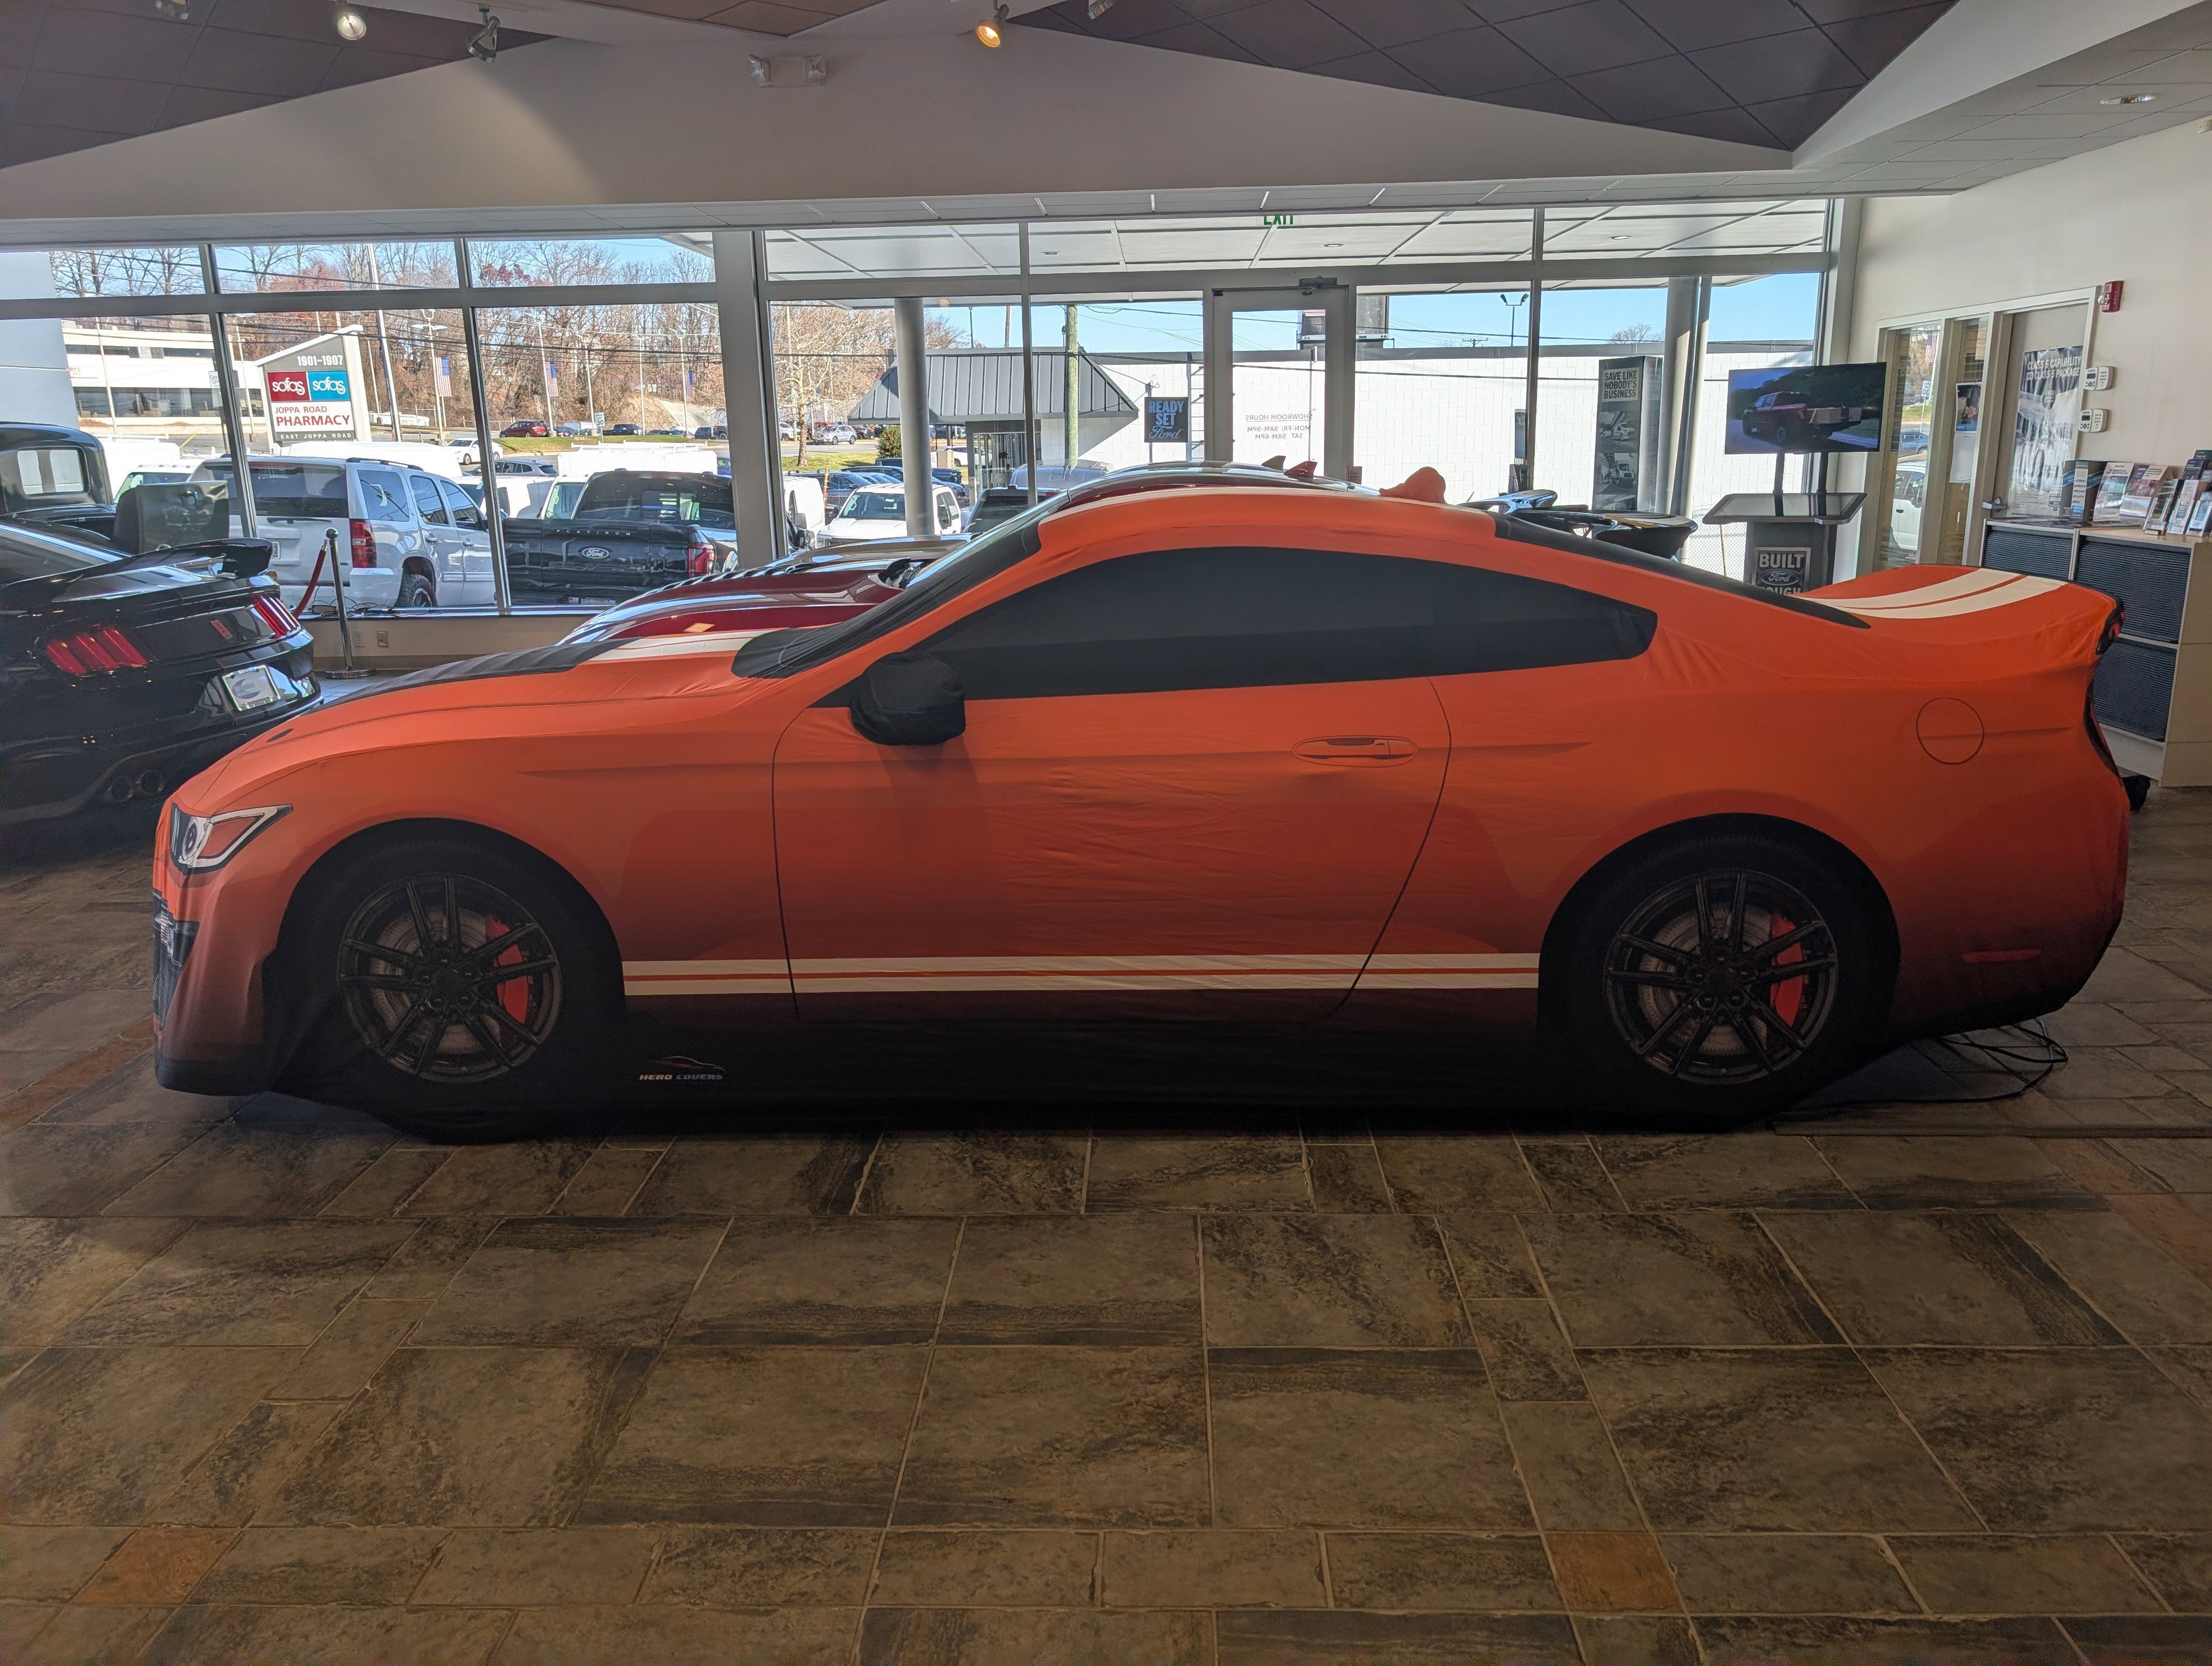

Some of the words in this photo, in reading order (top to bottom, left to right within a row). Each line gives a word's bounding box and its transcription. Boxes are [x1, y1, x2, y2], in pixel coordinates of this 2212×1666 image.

[297, 355, 343, 367] 1901-1907
[2028, 360, 2044, 370] CLASS
[2050, 356, 2082, 368] CAPABILITY
[1604, 371, 1622, 381] SAVE
[1623, 370, 1637, 380] LIKE
[2034, 369, 2050, 380] CLASS
[2055, 367, 2080, 378] PACKAGE
[272, 377, 305, 395] sofas
[312, 376, 346, 395] sofas
[1604, 380, 1637, 390] NOBODY'S
[1604, 389, 1636, 399] BUSINESS
[1148, 400, 1184, 413] READY
[276, 415, 350, 426] PHARMACY
[1155, 413, 1176, 426] SET
[1149, 426, 1182, 439] Ford
[587, 549, 605, 558] Ford
[1759, 553, 1804, 568] BUILT
[1768, 572, 1791, 582] Ford
